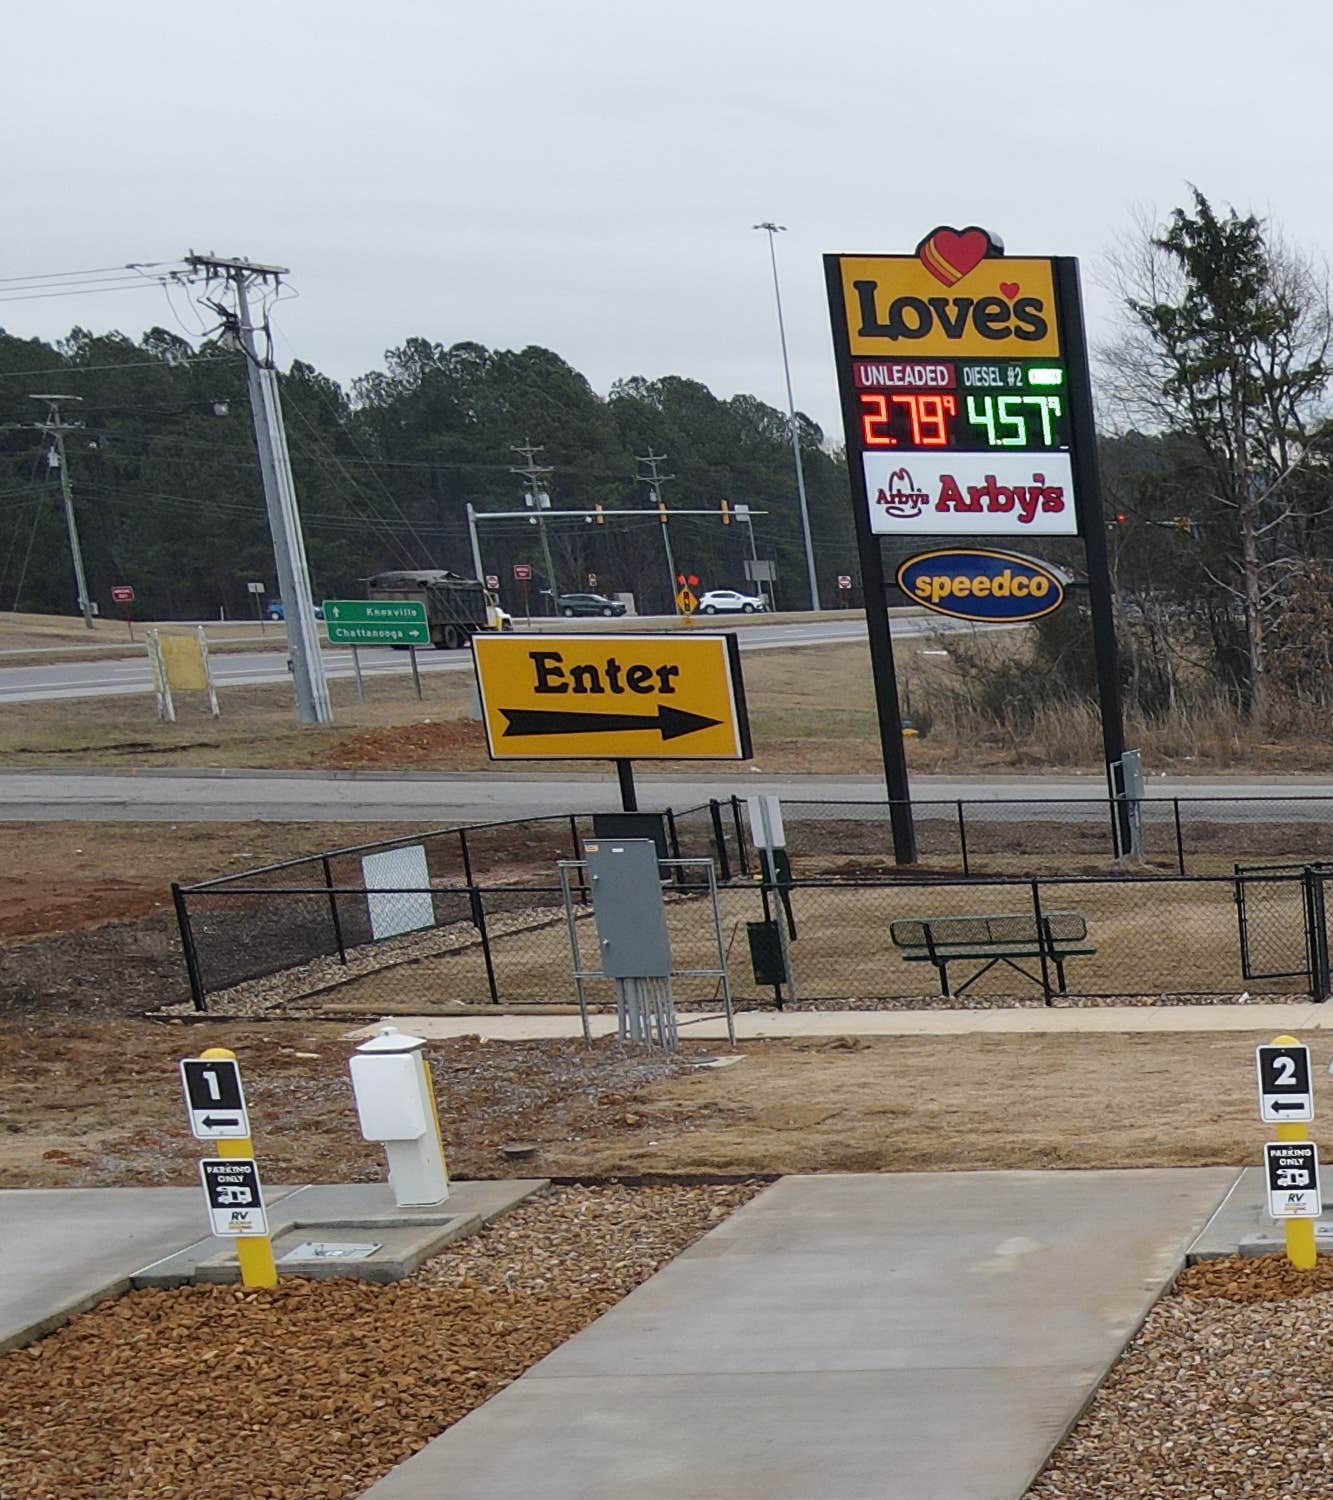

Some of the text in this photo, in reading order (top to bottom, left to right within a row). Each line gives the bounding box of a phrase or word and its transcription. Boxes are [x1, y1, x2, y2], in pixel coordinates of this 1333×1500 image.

[860, 366, 949, 386] UNLEADED
[963, 367, 1003, 386] DIESEL
[1006, 367, 1023, 387] #2
[876, 488, 930, 509] Arby's
[935, 473, 1065, 524] Arby's
[914, 569, 1049, 603] speedco
[366, 607, 417, 617] Knoxville
[335, 628, 404, 639] Chattanooga
[529, 651, 680, 694] Enter
[1272, 1056, 1297, 1085] 2
[202, 1071, 221, 1101] 1
[1270, 1149, 1312, 1157] PARKING
[206, 1165, 252, 1174] PARKING
[1279, 1158, 1304, 1166] ONLY
[217, 1175, 244, 1183] ONLY
[1287, 1192, 1304, 1202] RV
[231, 1211, 248, 1221] RV
